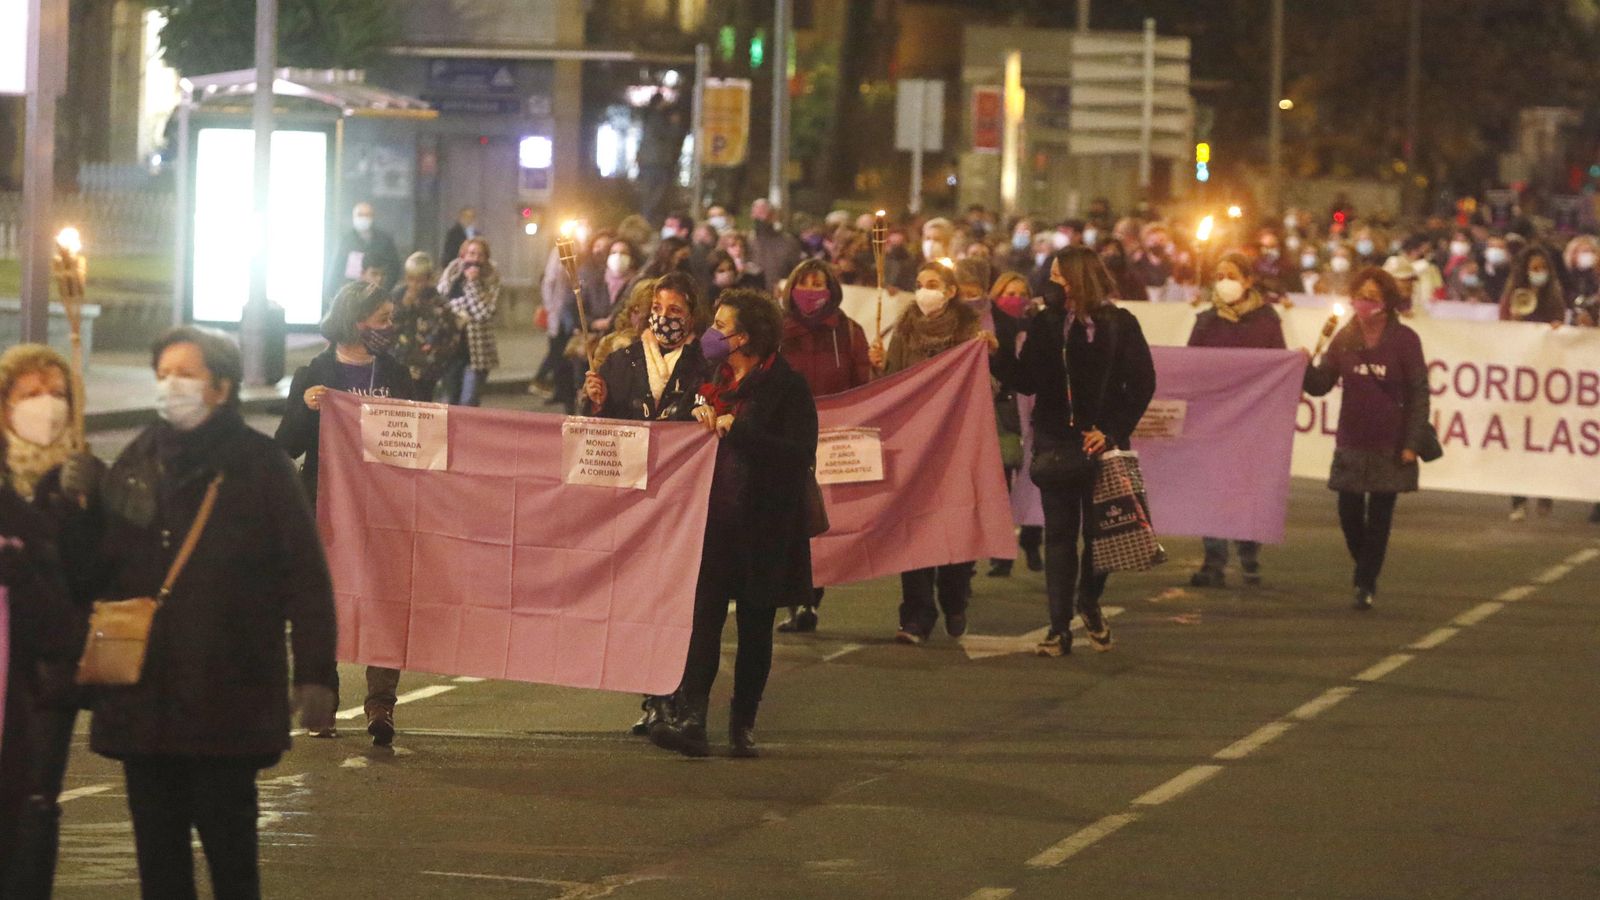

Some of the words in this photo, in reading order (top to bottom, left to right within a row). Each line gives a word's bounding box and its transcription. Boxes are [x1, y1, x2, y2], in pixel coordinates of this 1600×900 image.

[369, 409, 417, 419] SEPTIEMBRE
[418, 412, 434, 420] 2021
[391, 429, 412, 438] AÑOS
[569, 427, 620, 437] SEPTIEMBRE
[1482, 413, 1509, 450] A
[381, 450, 417, 458] ALICANTE
[595, 448, 617, 457] AÑOS
[579, 458, 623, 467] ASESINADA
[825, 459, 861, 467] ASESINADA
[587, 468, 621, 477] CORUÑA
